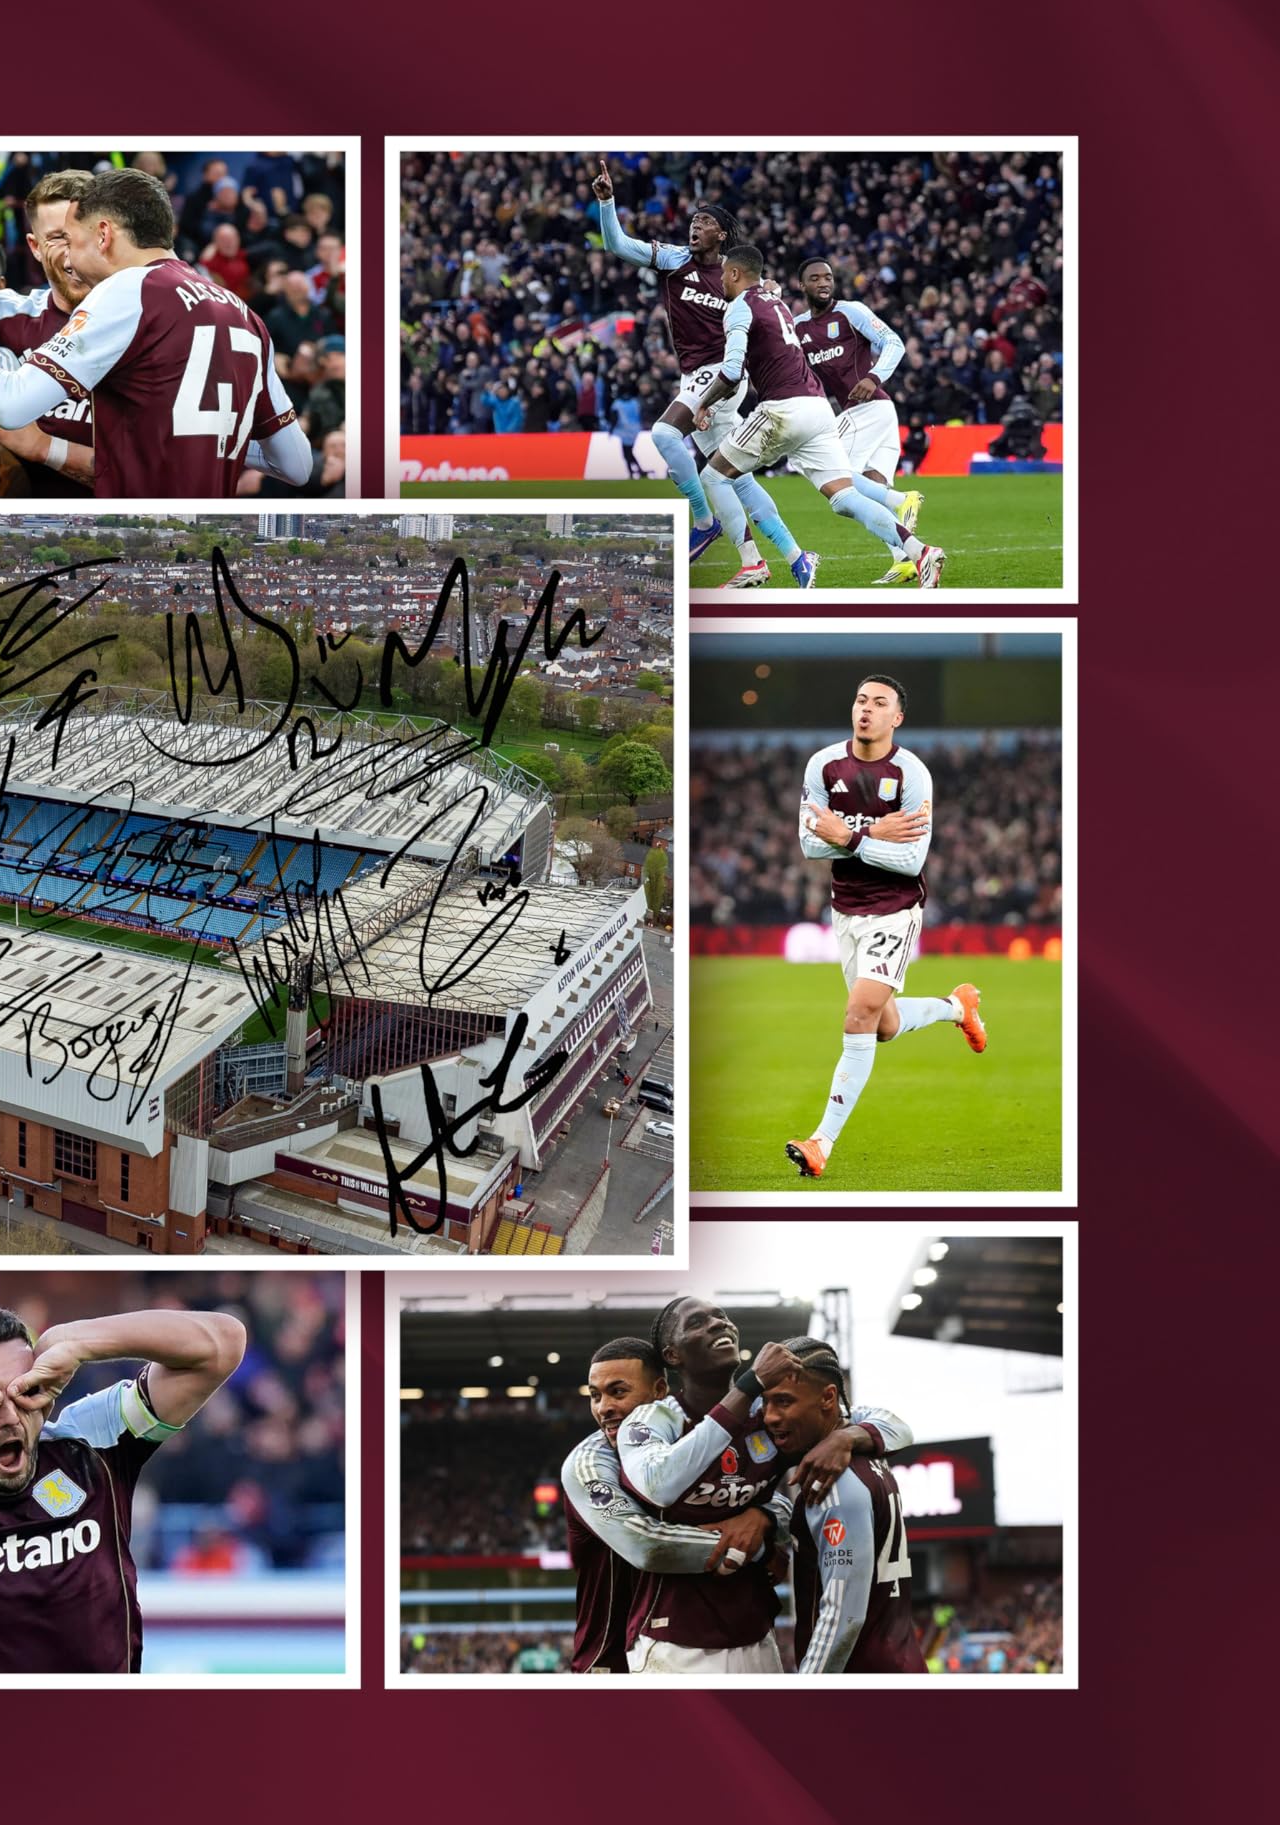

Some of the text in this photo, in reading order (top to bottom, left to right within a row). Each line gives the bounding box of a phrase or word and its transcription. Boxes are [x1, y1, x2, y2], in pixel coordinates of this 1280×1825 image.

[681, 287, 728, 311] Betan
[808, 345, 844, 366] Betano
[173, 325, 263, 460] 47
[866, 932, 903, 960] 27
[340, 1175, 355, 1188] THIS
[360, 1181, 378, 1195] VILLA
[378, 1187, 389, 1199] PA
[684, 1475, 775, 1508] Beta
[823, 1558, 853, 1568] NATION
[824, 1549, 853, 1561] TRADE
